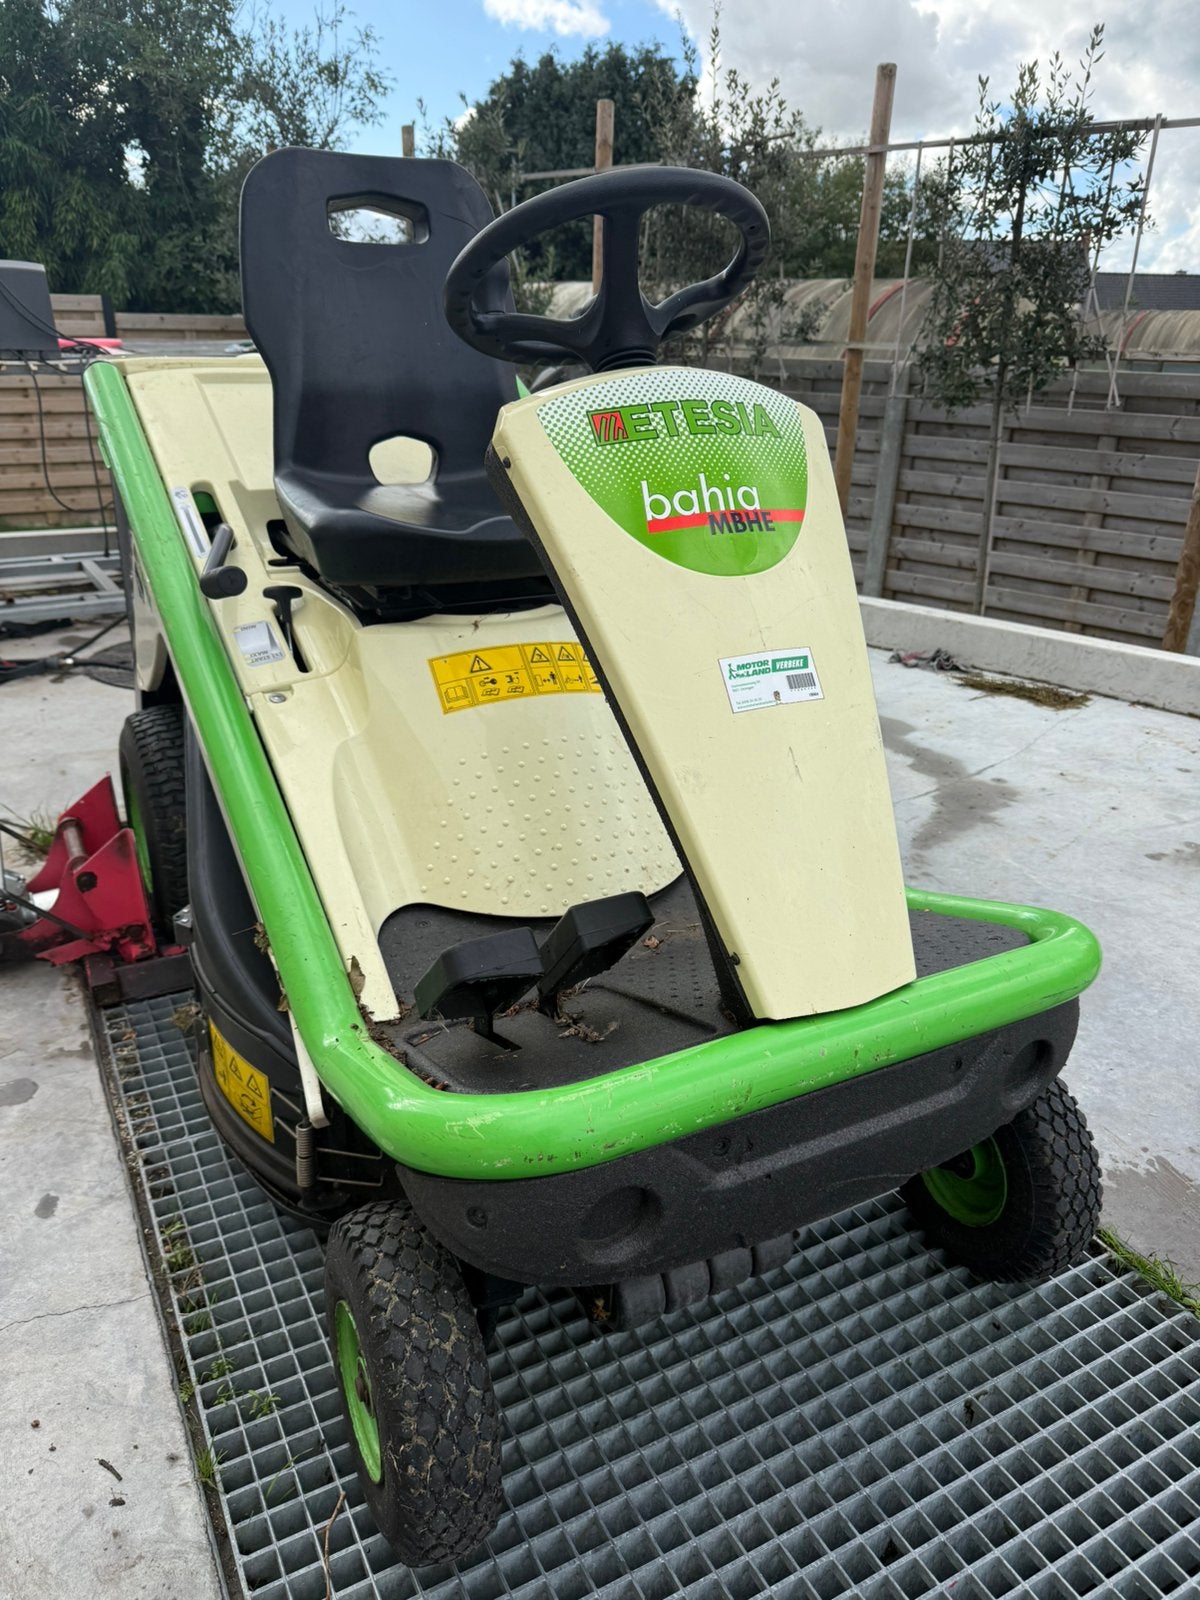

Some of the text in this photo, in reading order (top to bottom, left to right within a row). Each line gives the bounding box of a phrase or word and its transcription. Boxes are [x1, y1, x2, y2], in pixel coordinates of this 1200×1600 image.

[620, 399, 782, 444] ETESIA
[640, 473, 761, 521] bahia
[708, 511, 776, 536] MBHE
[736, 659, 770, 671] MOTOR
[745, 667, 771, 678] LAND
